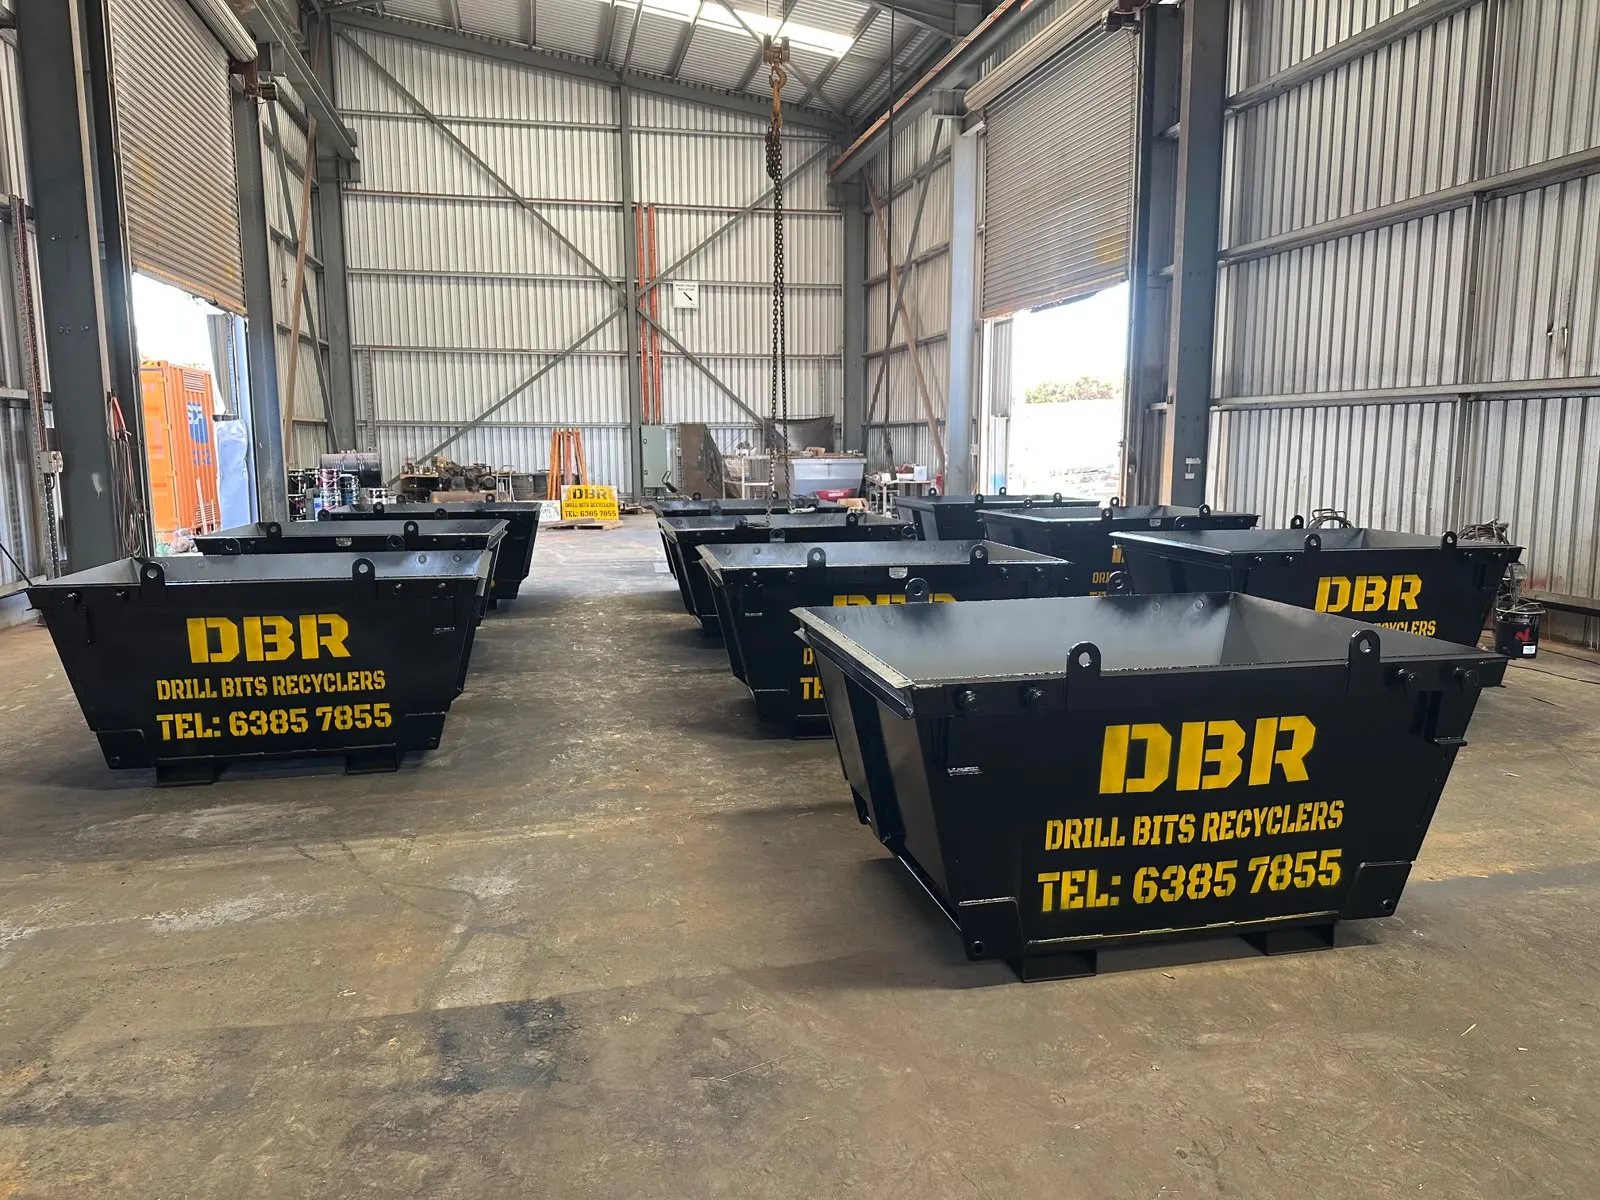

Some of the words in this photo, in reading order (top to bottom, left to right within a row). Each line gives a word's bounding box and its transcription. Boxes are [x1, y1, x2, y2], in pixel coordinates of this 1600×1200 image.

[573, 488, 607, 500] DBR
[1314, 574, 1422, 613] DBR
[186, 614, 352, 663] DBR
[156, 679, 217, 701] DRILL
[221, 676, 267, 698] BITS
[272, 670, 386, 696] RECYCLERS
[156, 711, 221, 741] TEL:
[229, 708, 309, 737] 6385
[316, 702, 393, 732] 7855
[1098, 715, 1317, 795] DBR
[1044, 816, 1126, 851] DRILL
[1131, 814, 1196, 846] BITS
[1201, 799, 1345, 843] RECYCLERS
[1037, 868, 1122, 912] TEL:
[1132, 859, 1238, 905] 6385
[1247, 848, 1343, 894] 7855
